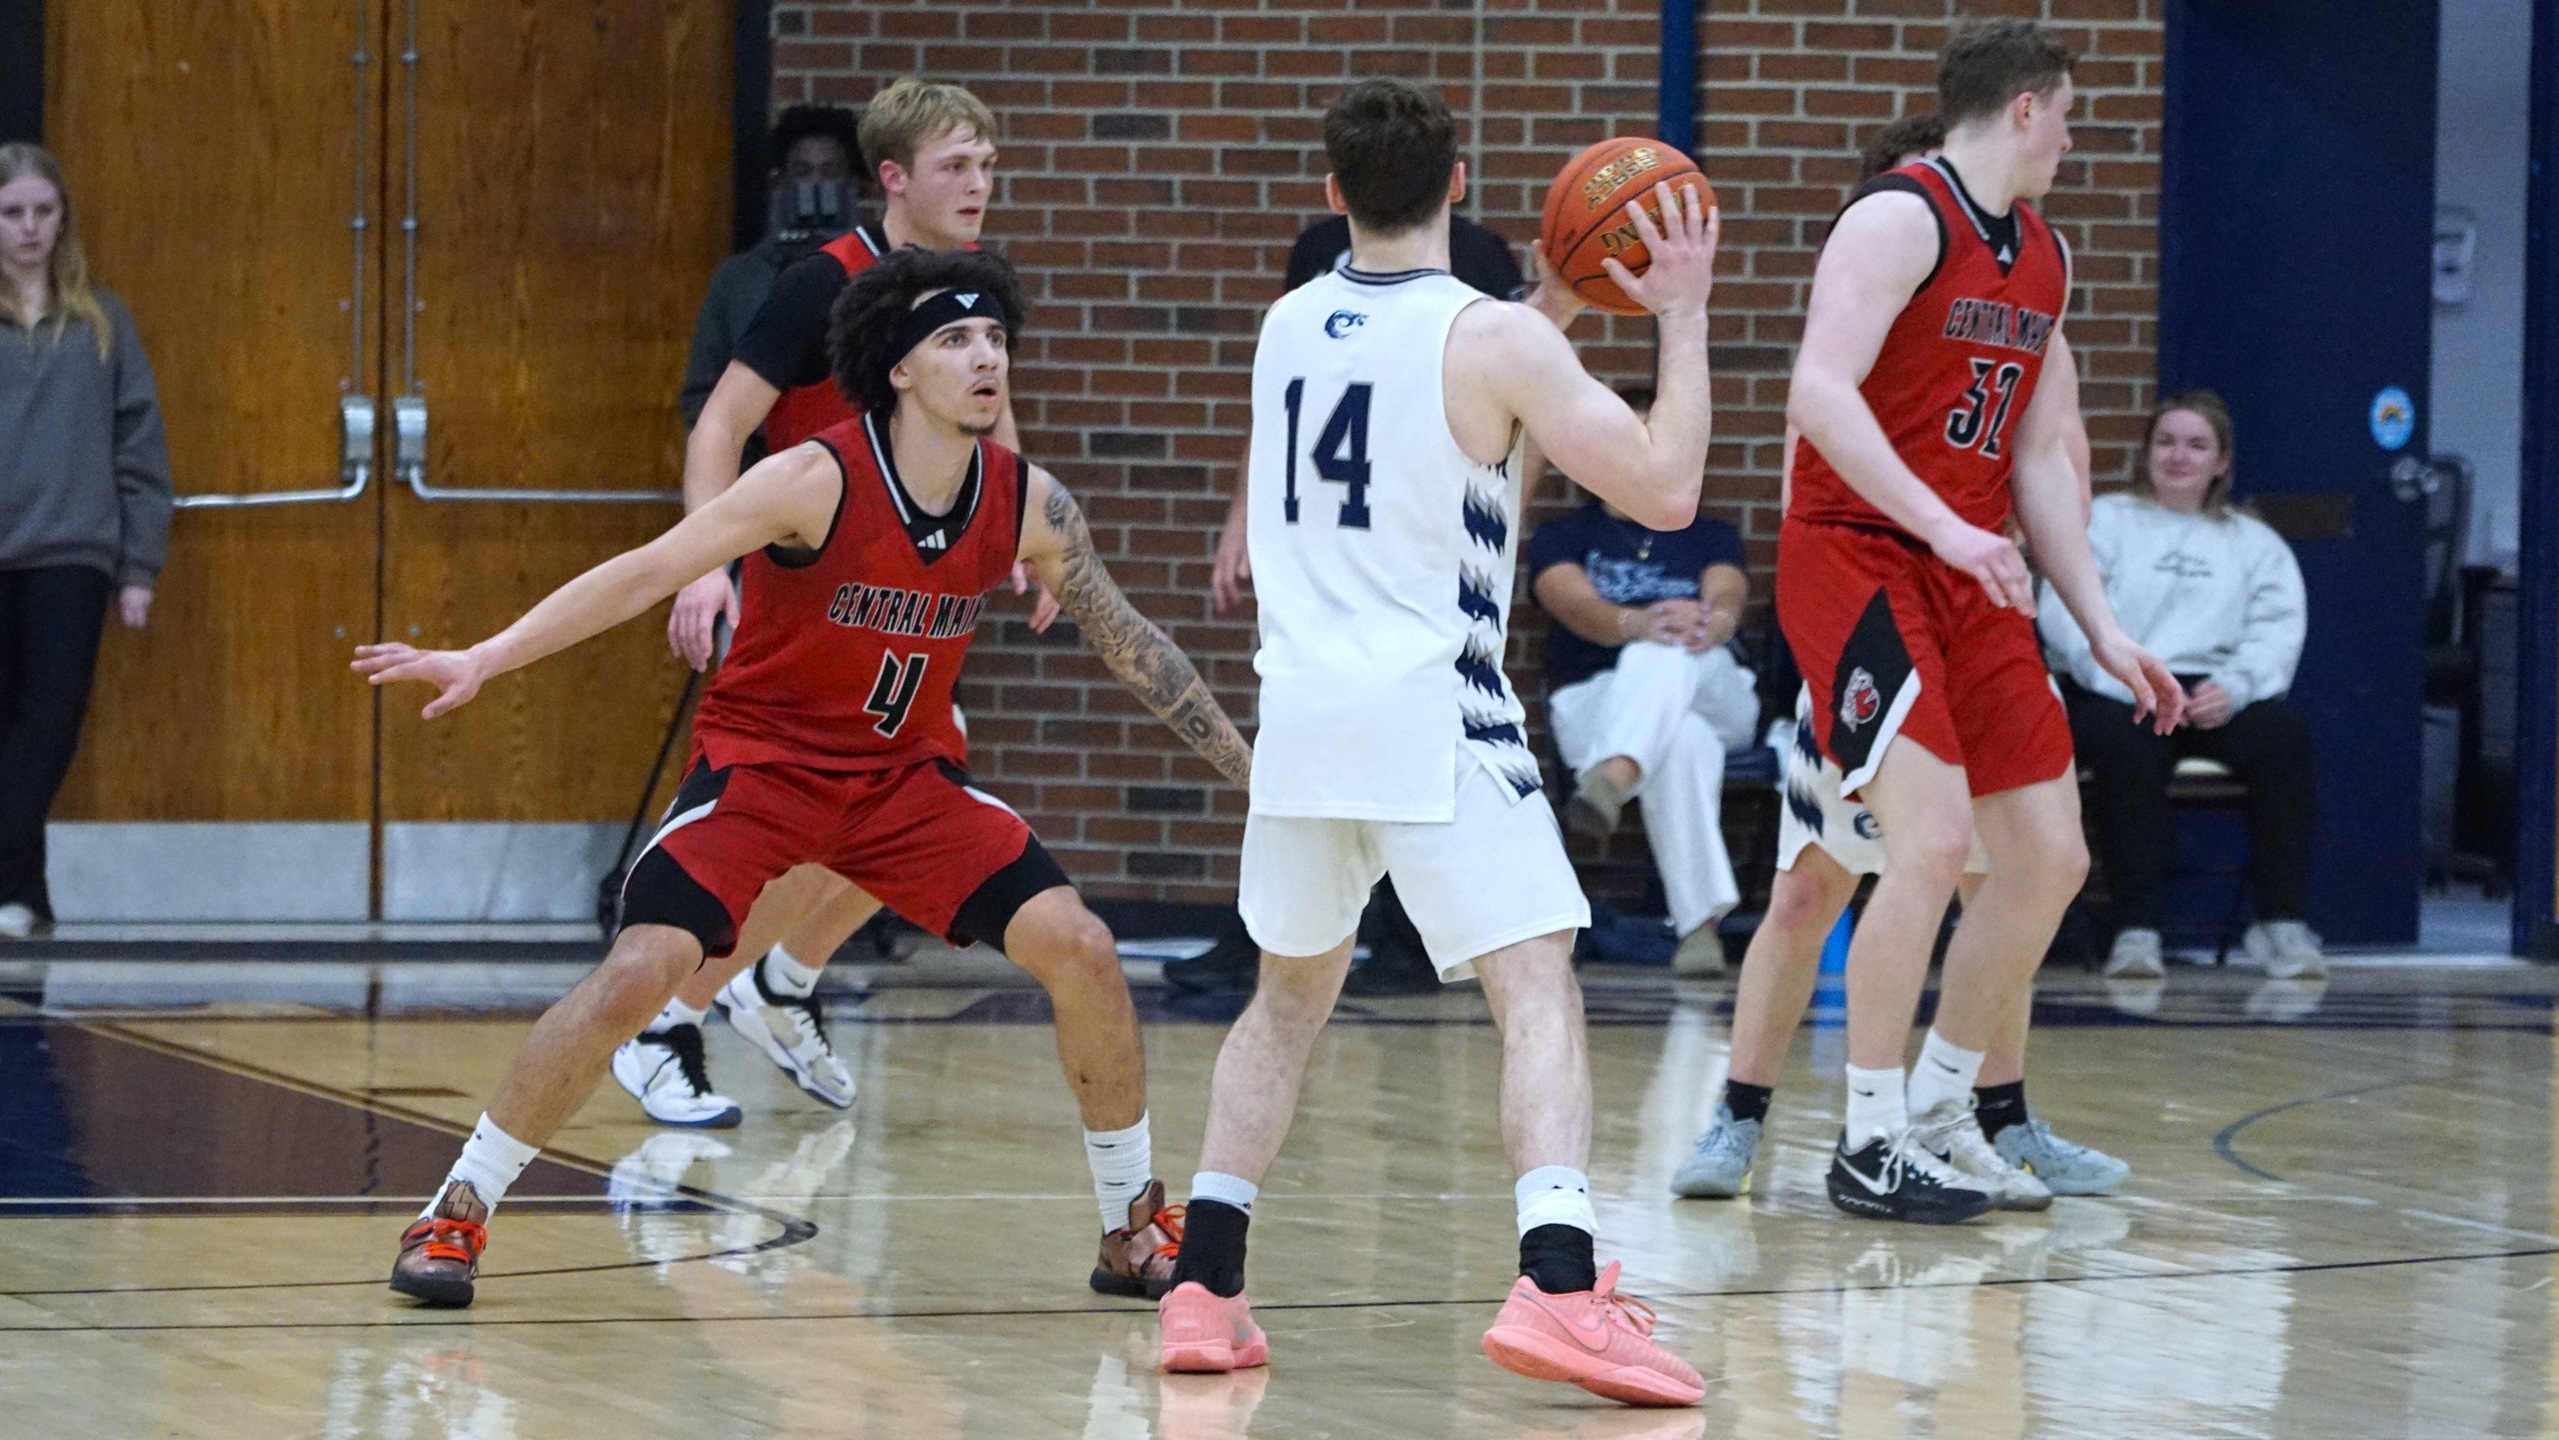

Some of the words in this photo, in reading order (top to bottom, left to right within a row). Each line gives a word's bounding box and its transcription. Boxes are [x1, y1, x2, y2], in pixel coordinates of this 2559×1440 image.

[1283, 376, 1374, 532] 14
[1944, 357, 2024, 461] 32
[827, 582, 932, 636] CENTRAL
[862, 648, 929, 739] 4
